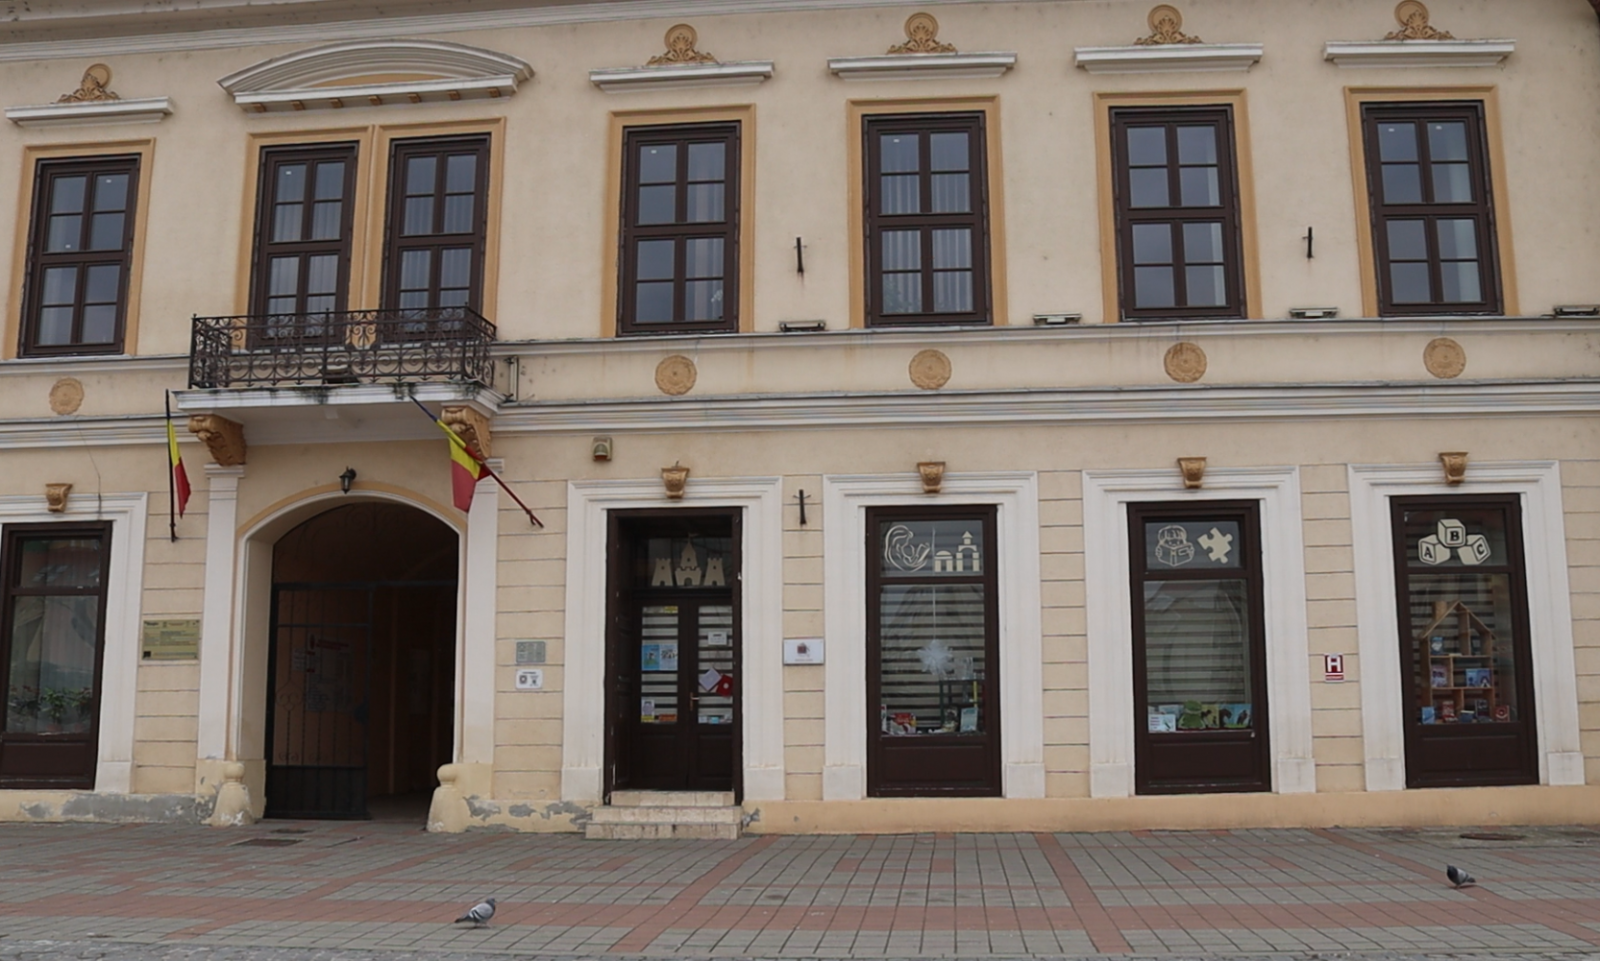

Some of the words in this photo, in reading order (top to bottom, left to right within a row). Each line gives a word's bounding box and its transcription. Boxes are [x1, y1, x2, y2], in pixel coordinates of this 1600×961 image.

[1450, 530, 1460, 541] B
[1424, 546, 1433, 559] A
[1476, 543, 1485, 556] C
[1327, 655, 1341, 672] H
